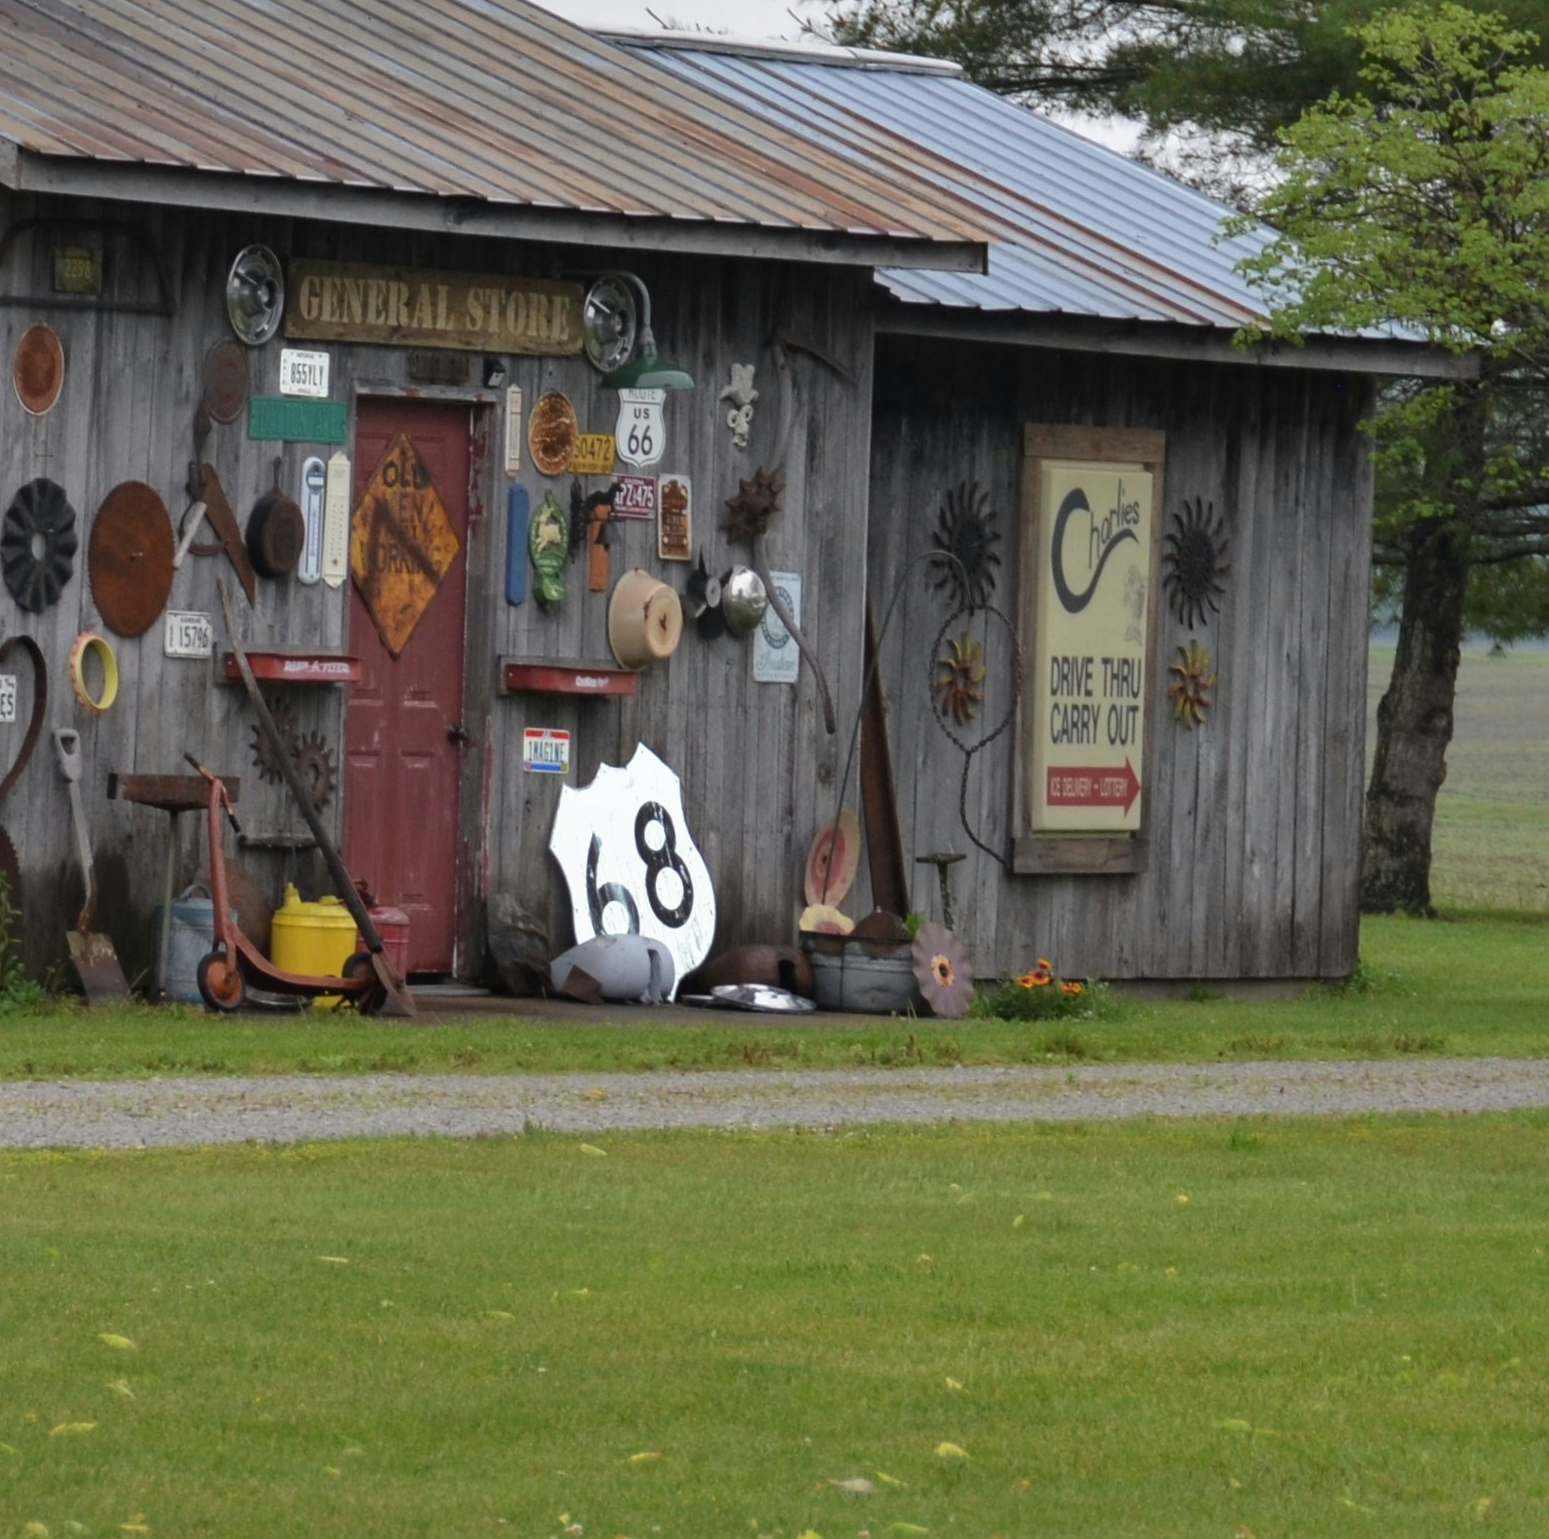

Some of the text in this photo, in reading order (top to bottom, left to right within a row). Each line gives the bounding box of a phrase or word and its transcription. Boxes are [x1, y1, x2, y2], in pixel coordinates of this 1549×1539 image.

[301, 275, 570, 341] GENERAL STORE
[290, 362, 324, 387] 855YLY
[633, 407, 651, 420] US
[628, 423, 653, 456] 66
[1052, 478, 1140, 614] Charlies
[1051, 656, 1142, 699] DRIVE THRU
[1051, 702, 1139, 747] CARRY OUT
[1062, 776, 1092, 798] DELIVERY
[1100, 776, 1128, 799] LOTTERY
